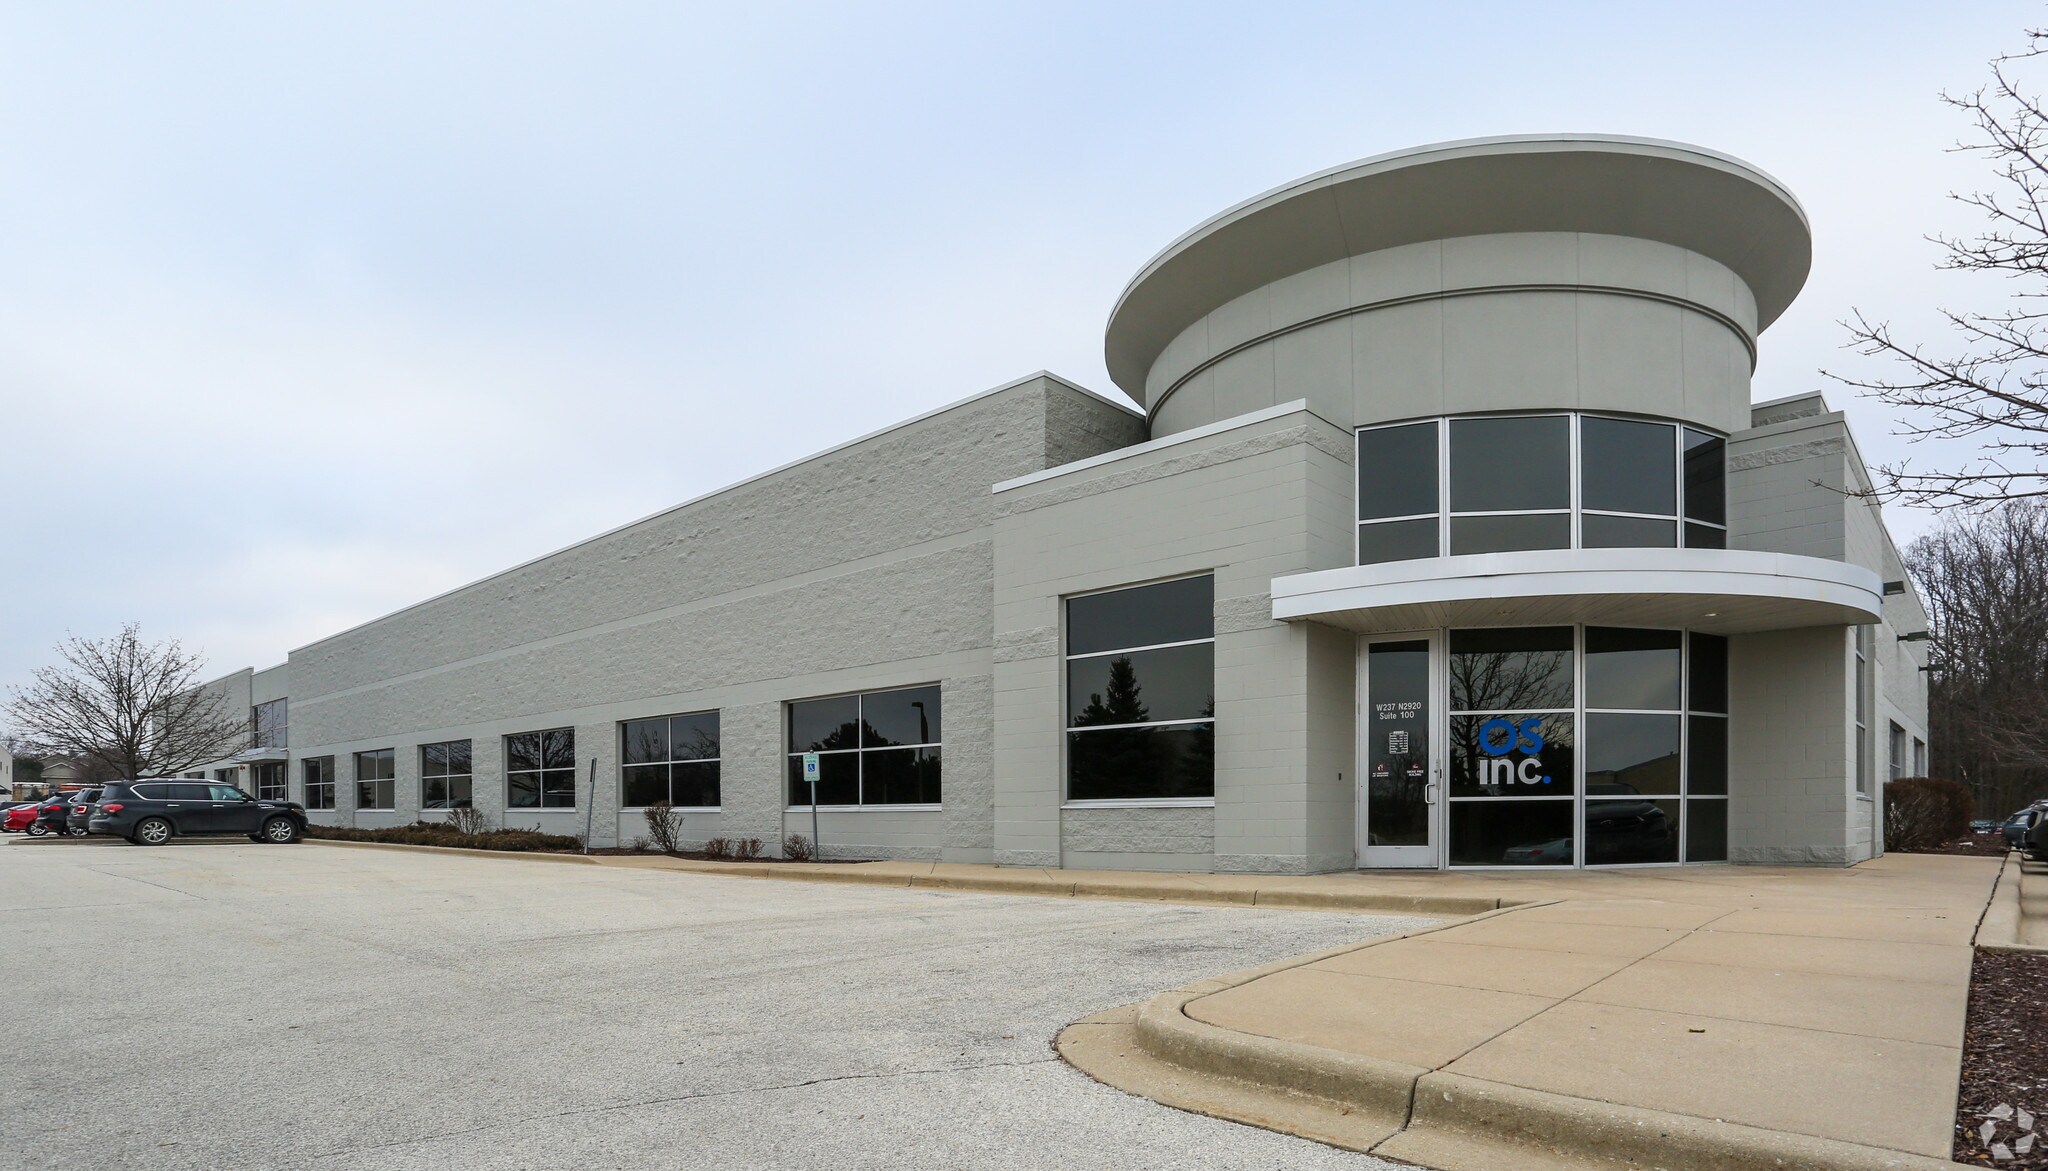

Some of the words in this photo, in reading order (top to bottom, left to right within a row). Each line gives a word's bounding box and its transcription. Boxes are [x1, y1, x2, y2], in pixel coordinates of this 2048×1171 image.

[1376, 703, 1396, 711] W237
[1398, 702, 1422, 710] N2920
[1379, 712, 1397, 720] Suite
[1400, 711, 1415, 719] 100
[1479, 717, 1544, 756] OS
[1480, 758, 1552, 785] inc.
